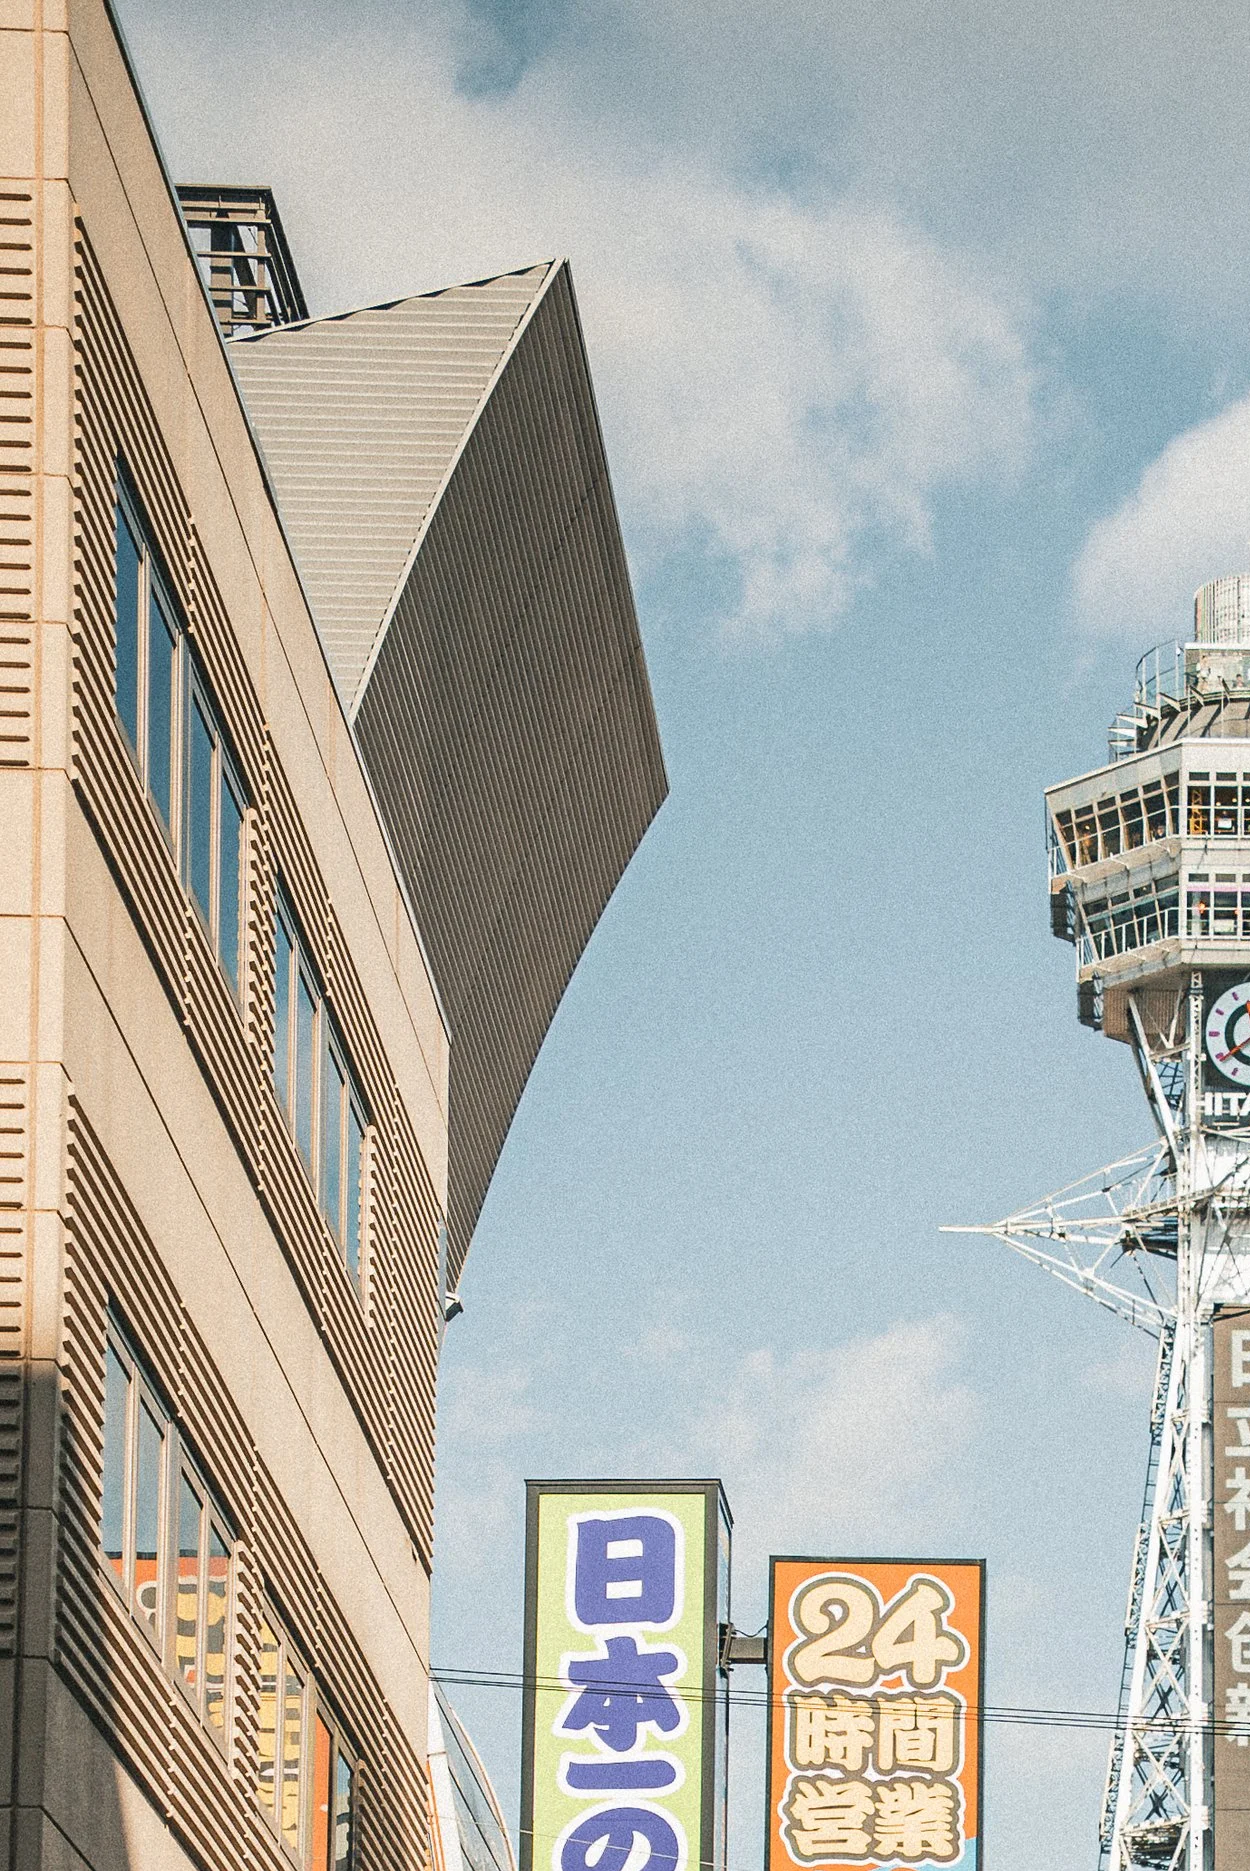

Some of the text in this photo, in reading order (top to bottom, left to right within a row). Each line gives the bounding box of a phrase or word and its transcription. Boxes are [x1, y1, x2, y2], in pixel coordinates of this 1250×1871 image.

[788, 1575, 965, 1687] 24
[791, 1693, 957, 1776] 時間
[789, 1779, 959, 1859] 営業
